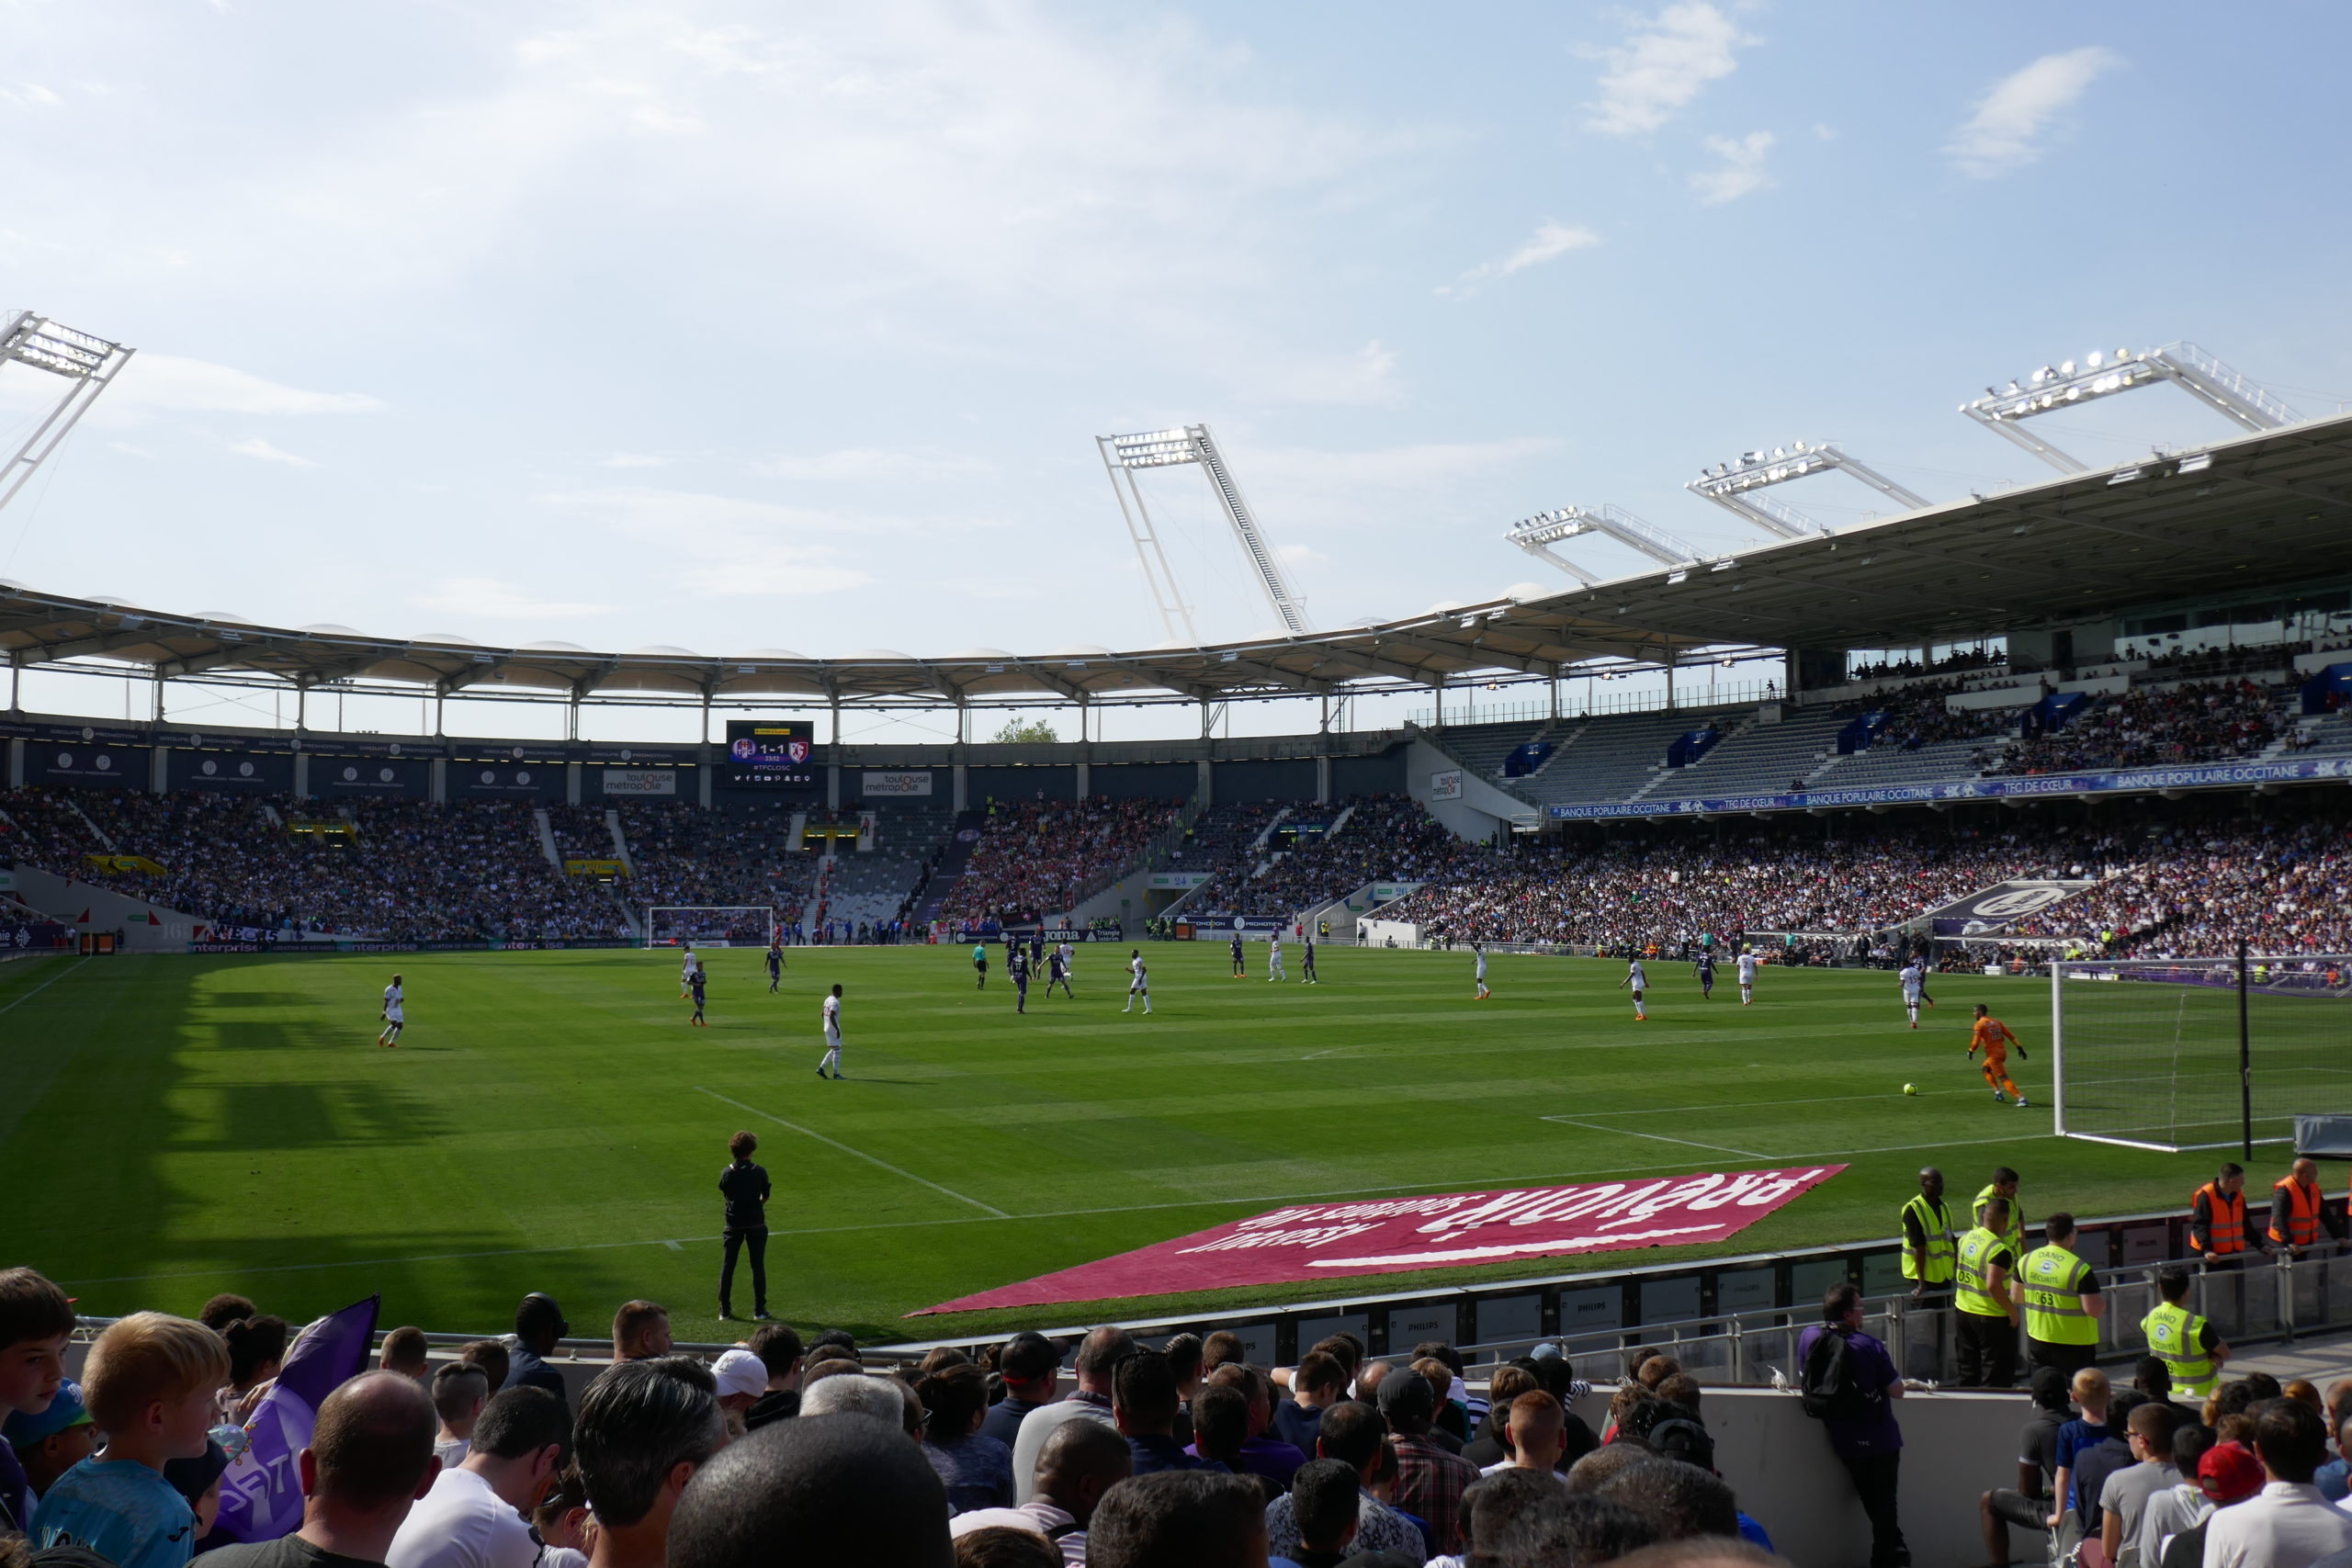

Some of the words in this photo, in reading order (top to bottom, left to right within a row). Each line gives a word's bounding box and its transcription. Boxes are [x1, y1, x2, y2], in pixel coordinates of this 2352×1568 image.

[627, 773, 673, 783] toulouse
[885, 775, 930, 784] toulouse
[1440, 776, 1460, 785] toulouse
[2117, 774, 2165, 788] BANQUE
[2166, 769, 2230, 785] POPULAIRE
[2233, 764, 2299, 781] OCCITANE
[2003, 782, 2022, 793] TFC
[2024, 781, 2039, 792] DE
[1806, 794, 1840, 805] BANQUE
[1842, 790, 1885, 804] POPULAIRE
[1887, 787, 1933, 800] OCCITANE
[1724, 799, 1739, 809] TFC
[1740, 798, 1750, 808] DE
[1560, 807, 1593, 818] BANQUE
[1593, 805, 1632, 817] POPULAIRE
[1633, 803, 1670, 814] OCCITANE
[2037, 1250, 2065, 1262] DANO
[2036, 1292, 2054, 1305] 063
[1577, 1301, 1606, 1314] PHILIPS
[2154, 1312, 2177, 1325] DANO
[1407, 1320, 1439, 1333] PHILIPS
